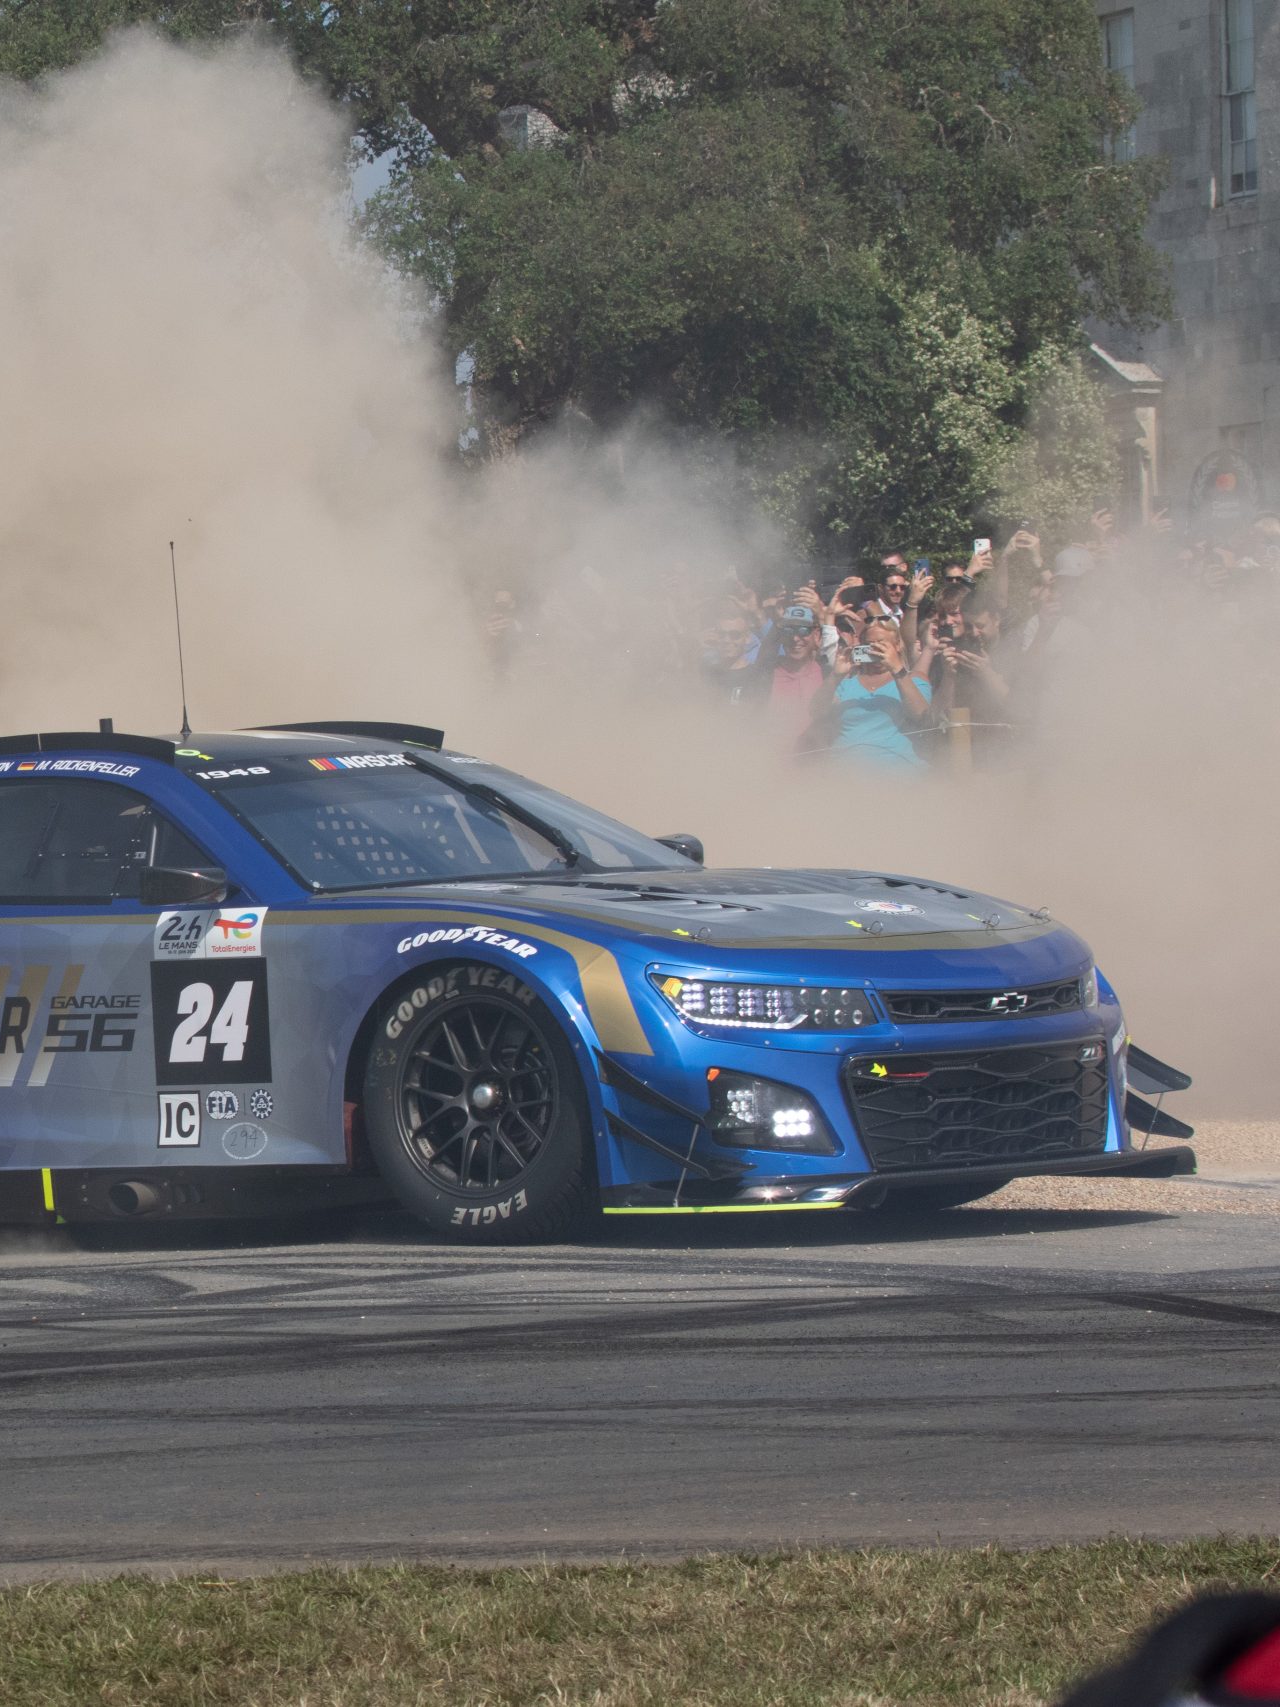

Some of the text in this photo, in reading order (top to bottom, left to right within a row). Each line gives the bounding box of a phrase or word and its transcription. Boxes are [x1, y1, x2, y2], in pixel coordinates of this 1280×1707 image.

[49, 759, 141, 778] ROCKENFELLER
[335, 753, 417, 769] NASCA
[195, 765, 271, 780] 1948
[158, 941, 199, 950] LE MANS
[211, 944, 257, 954] TotalEnergies
[396, 925, 539, 959] GOODYEAR
[49, 994, 141, 1010] GARAGE
[169, 980, 254, 1063] 24
[43, 1013, 139, 1053] 56
[164, 1101, 196, 1139] IC
[451, 1189, 528, 1226] EAGLE
